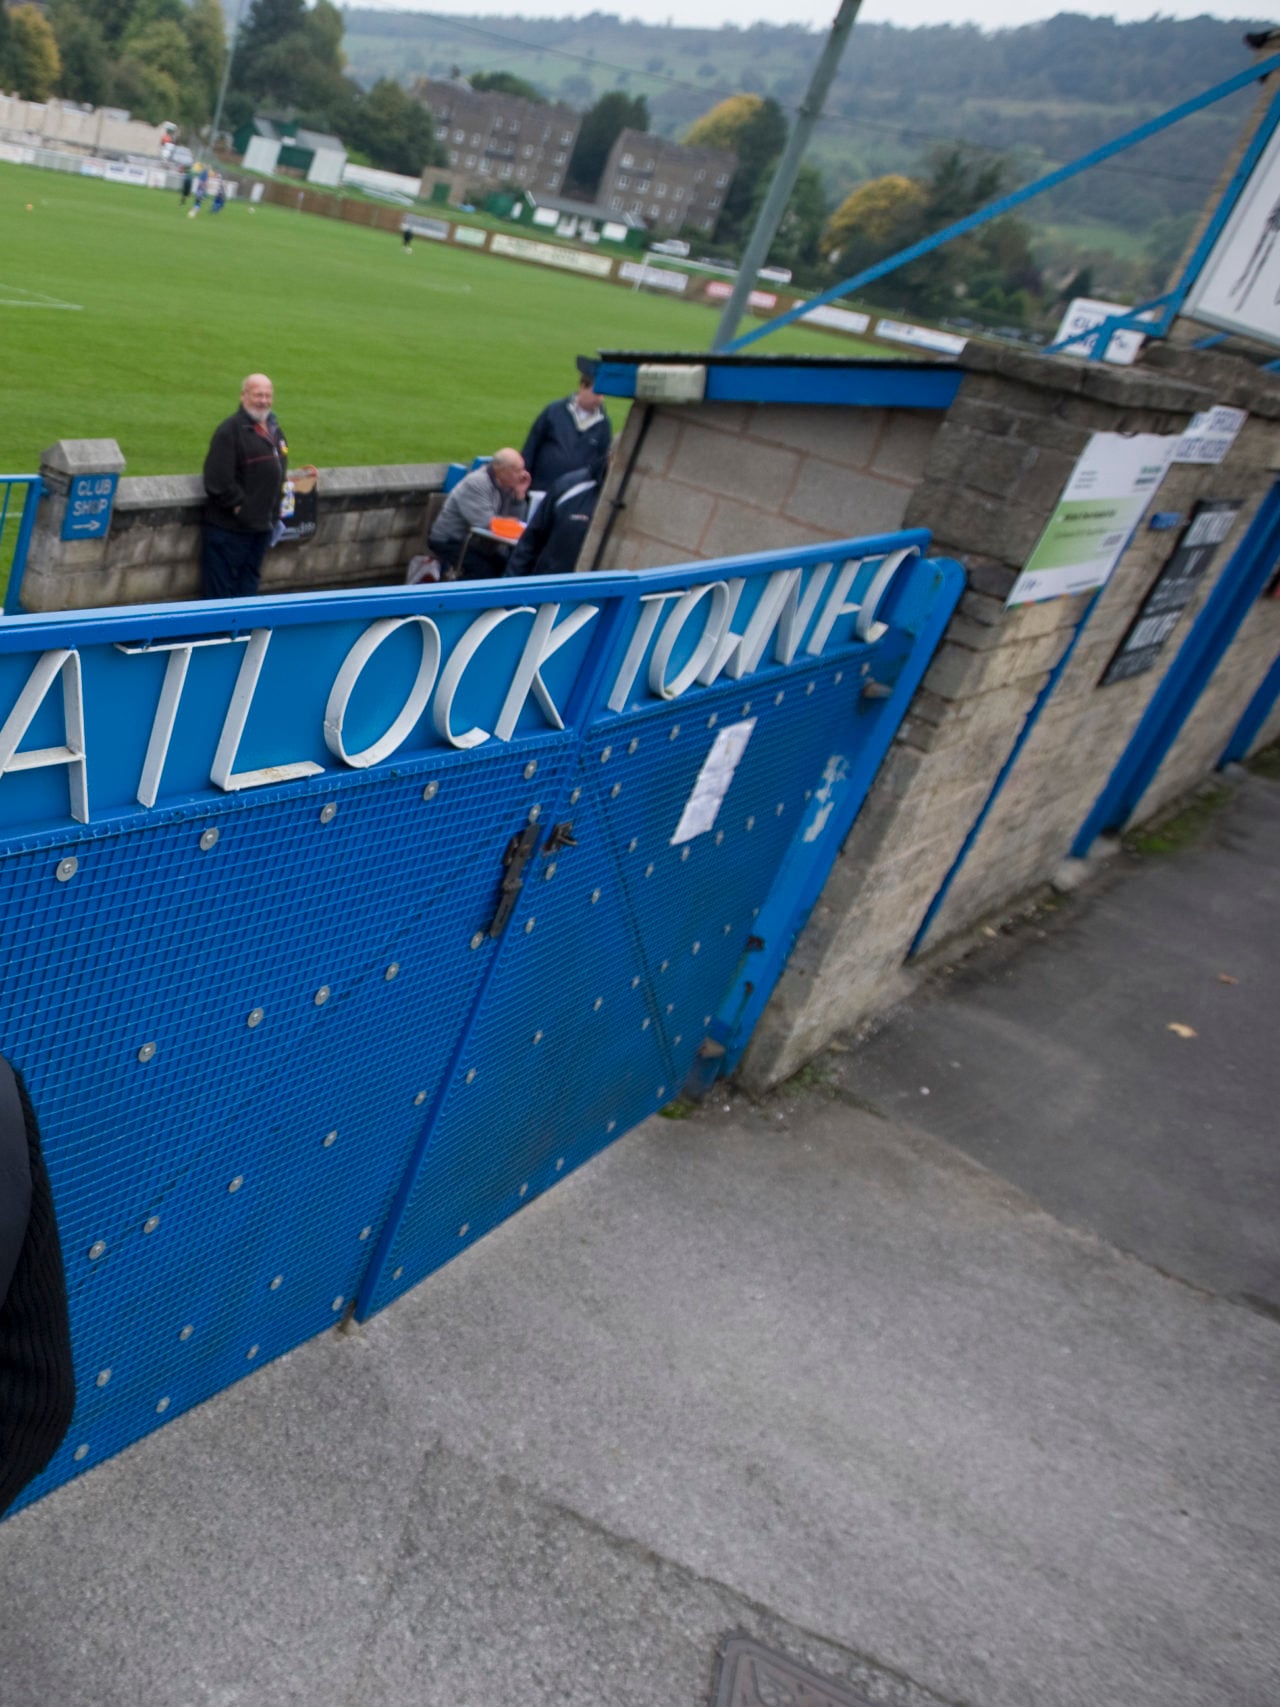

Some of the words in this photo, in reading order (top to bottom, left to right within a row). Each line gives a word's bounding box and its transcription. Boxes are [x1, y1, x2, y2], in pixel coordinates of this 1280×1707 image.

[77, 479, 113, 497] CLUB
[72, 498, 109, 516] SHOP
[607, 562, 834, 714] TOWN
